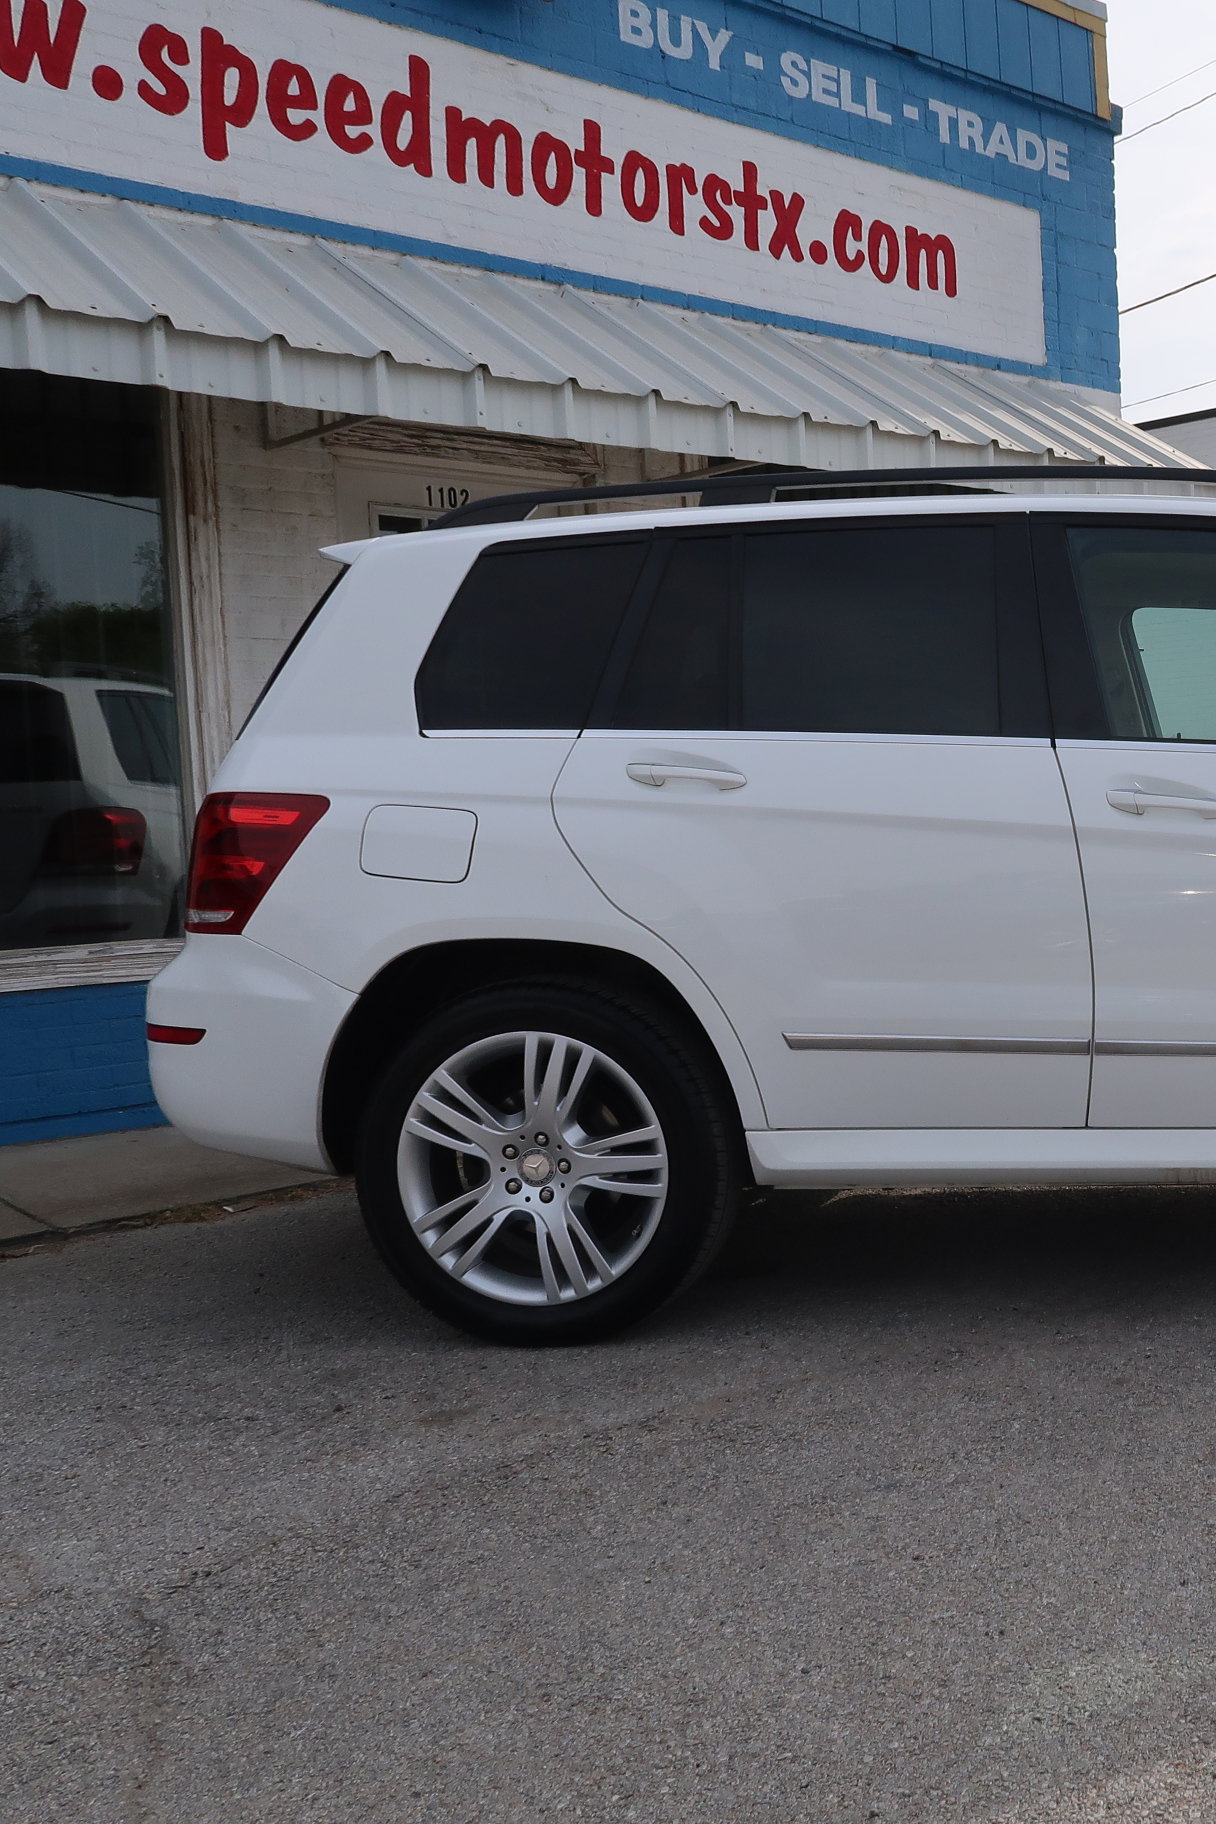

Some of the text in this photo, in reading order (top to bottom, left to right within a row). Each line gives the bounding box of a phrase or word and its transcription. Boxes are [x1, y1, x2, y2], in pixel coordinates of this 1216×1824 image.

[619, 0, 733, 72] BUY
[780, 51, 892, 125] SELL
[928, 98, 1070, 181] TRADE
[425, 484, 470, 508] 1102
